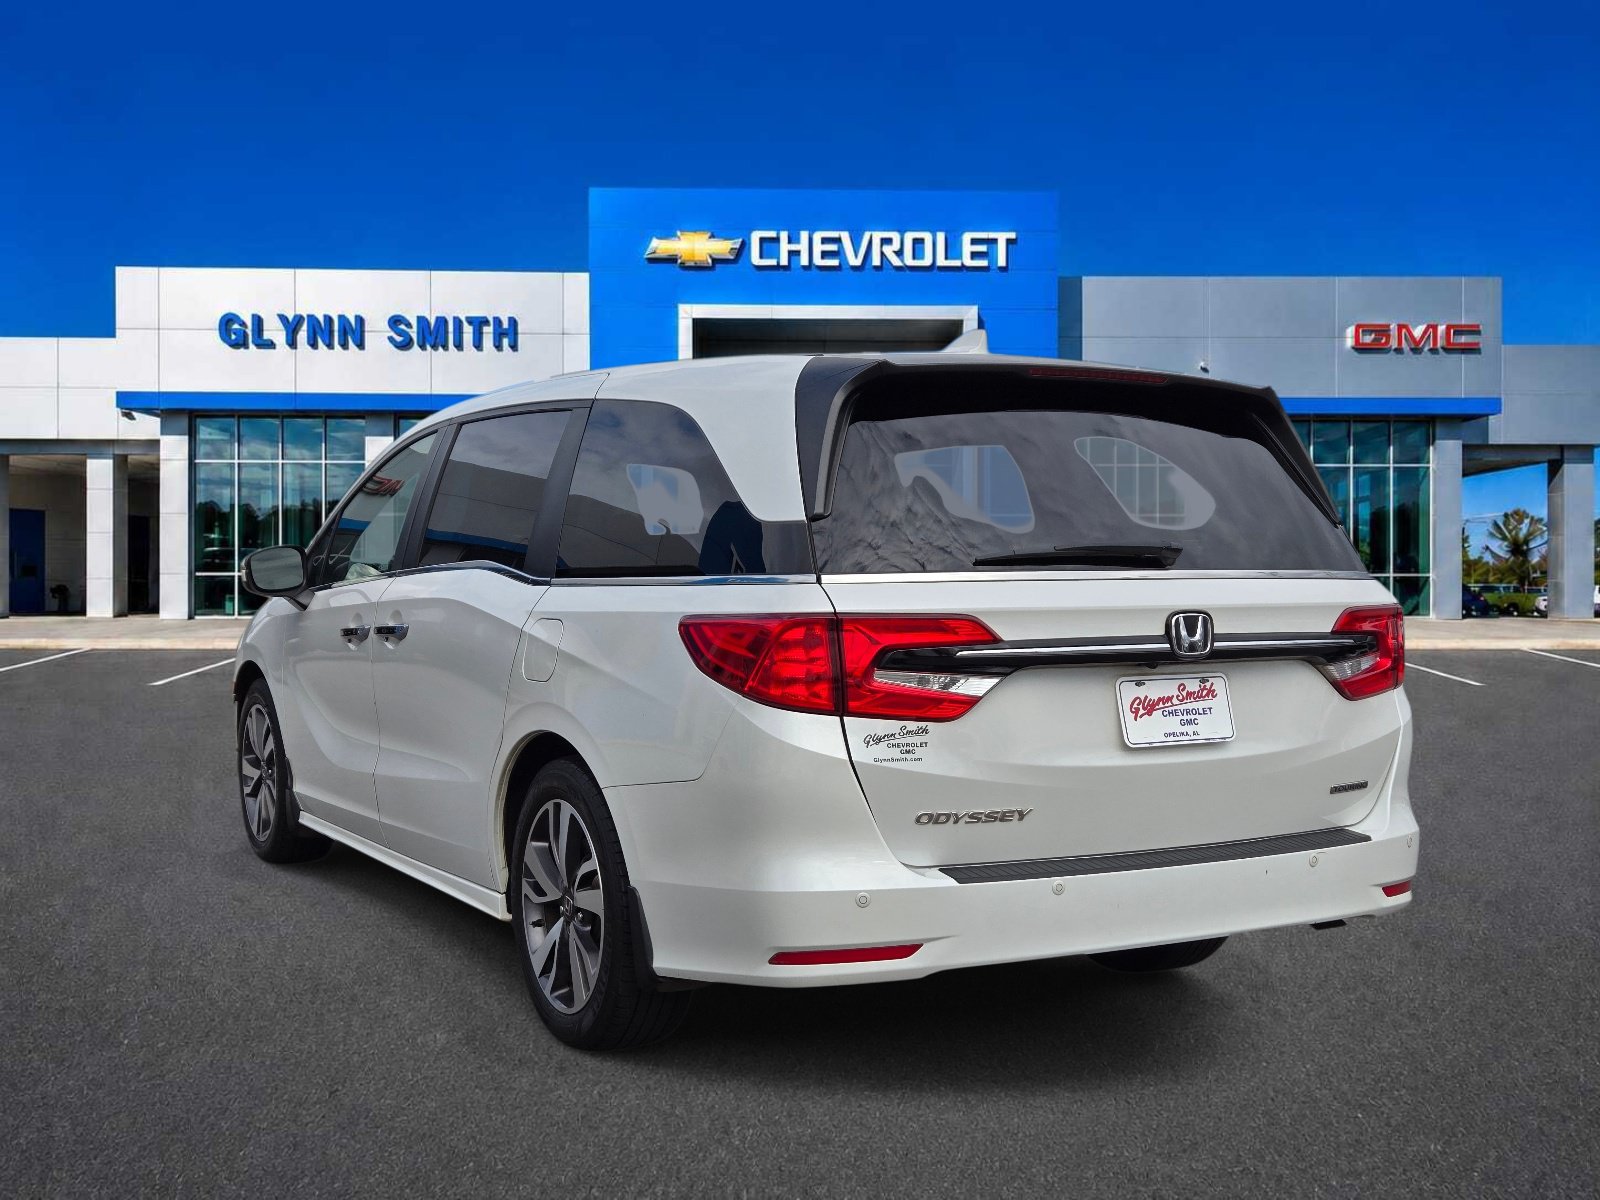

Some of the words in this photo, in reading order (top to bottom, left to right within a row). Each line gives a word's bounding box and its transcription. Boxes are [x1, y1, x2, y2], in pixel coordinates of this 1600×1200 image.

[750, 230, 1017, 269] CHEVROLET
[218, 312, 365, 350] GLYNN
[387, 314, 518, 352] SMITH
[1350, 323, 1482, 353] GMC
[1129, 694, 1175, 721] Glynn
[1176, 682, 1218, 702] Smith
[1161, 707, 1213, 717] CHEVROLET
[1179, 718, 1199, 726] GMC
[863, 732, 897, 749] Glynn
[898, 724, 930, 737] Smith
[886, 741, 929, 749] CHEVROLET
[915, 808, 1034, 825] ODYSSEY
